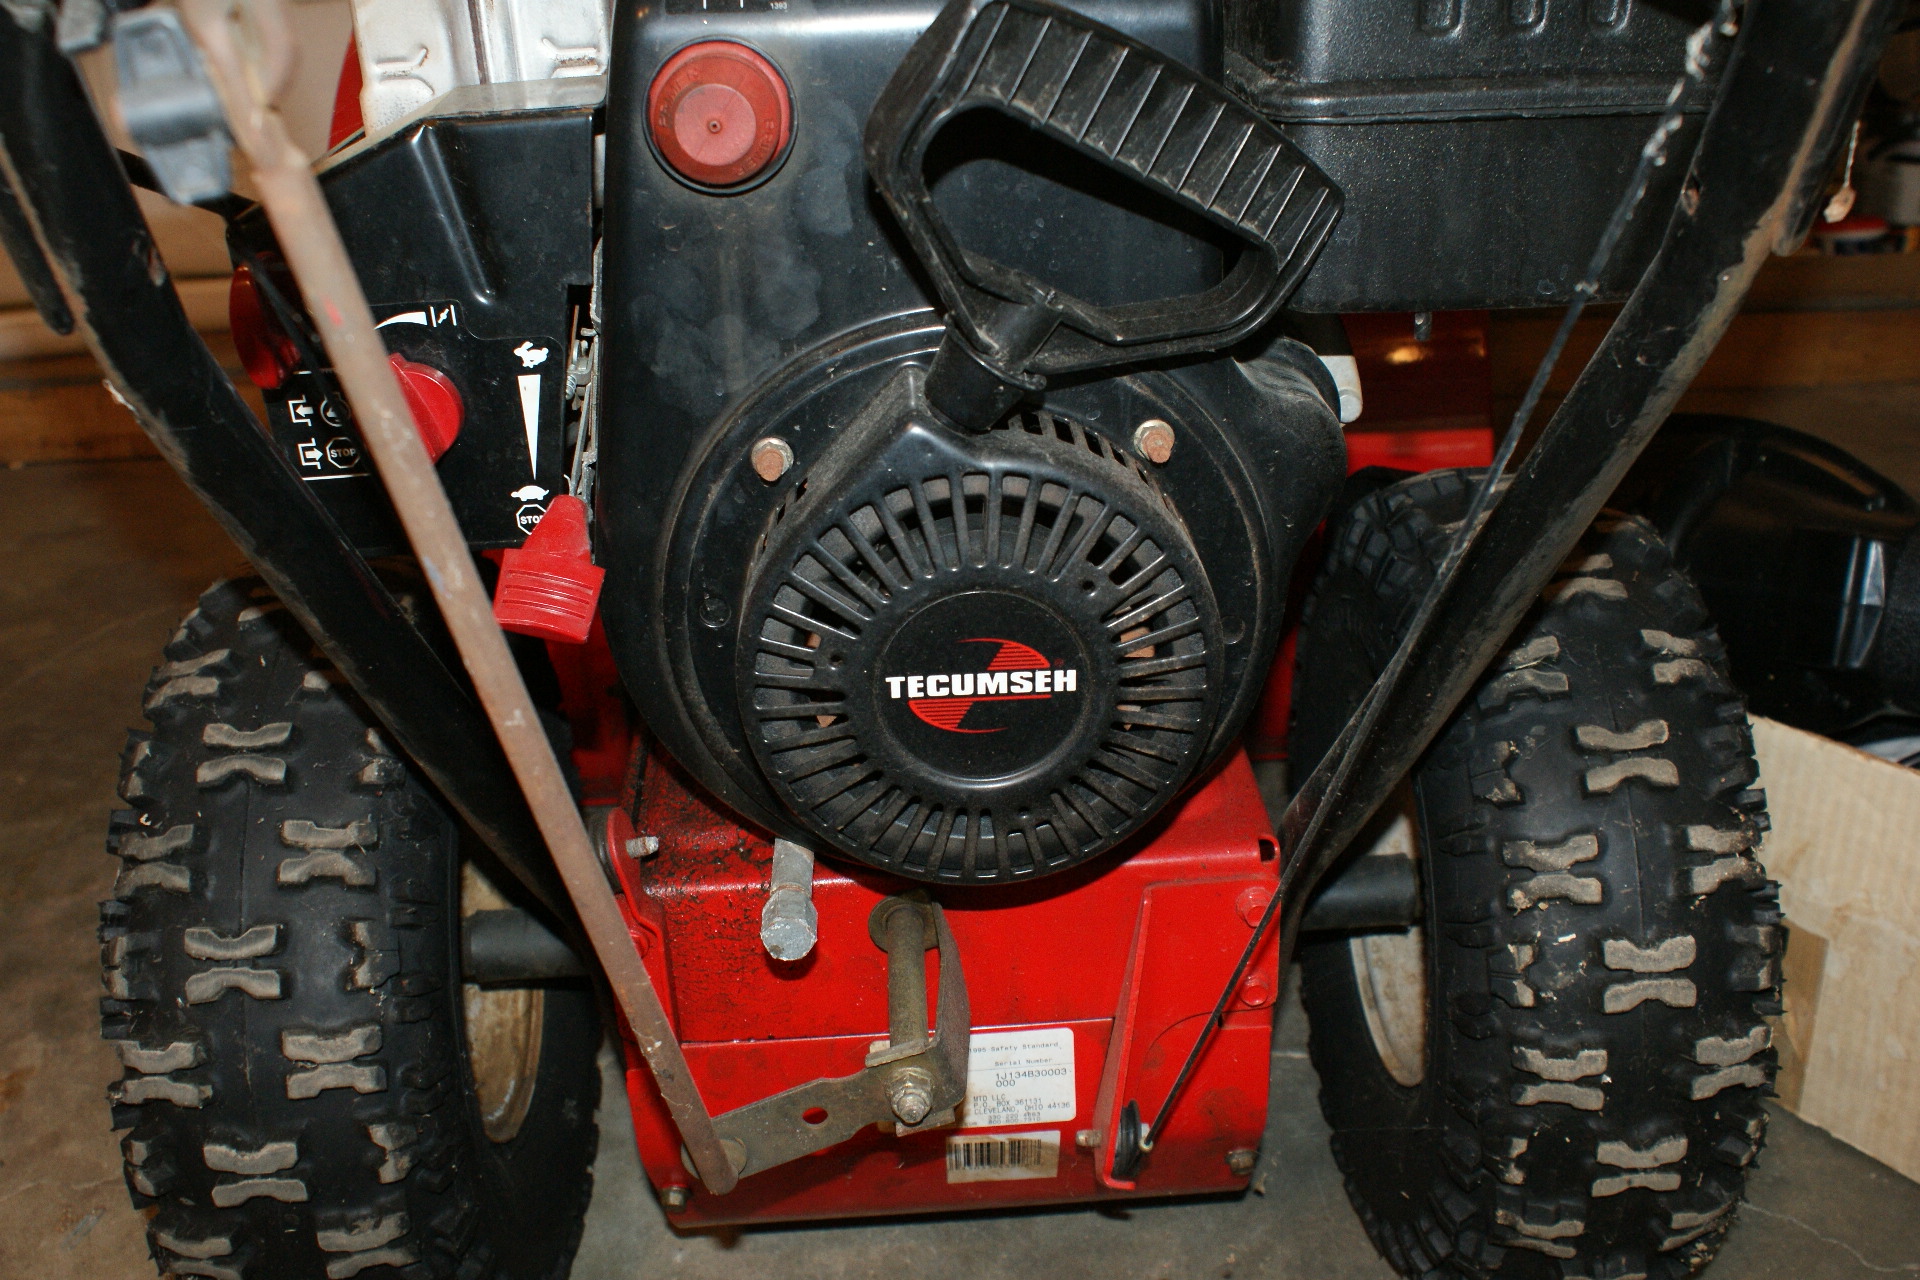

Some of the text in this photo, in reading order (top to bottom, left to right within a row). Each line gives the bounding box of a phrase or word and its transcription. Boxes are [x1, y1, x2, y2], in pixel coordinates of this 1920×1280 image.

[330, 448, 356, 458] STOP
[885, 669, 1077, 699] TECUMSEH
[990, 1045, 1018, 1053] Safety
[995, 1068, 1067, 1080] 1J134B30003
[991, 1093, 1006, 1101] LLC
